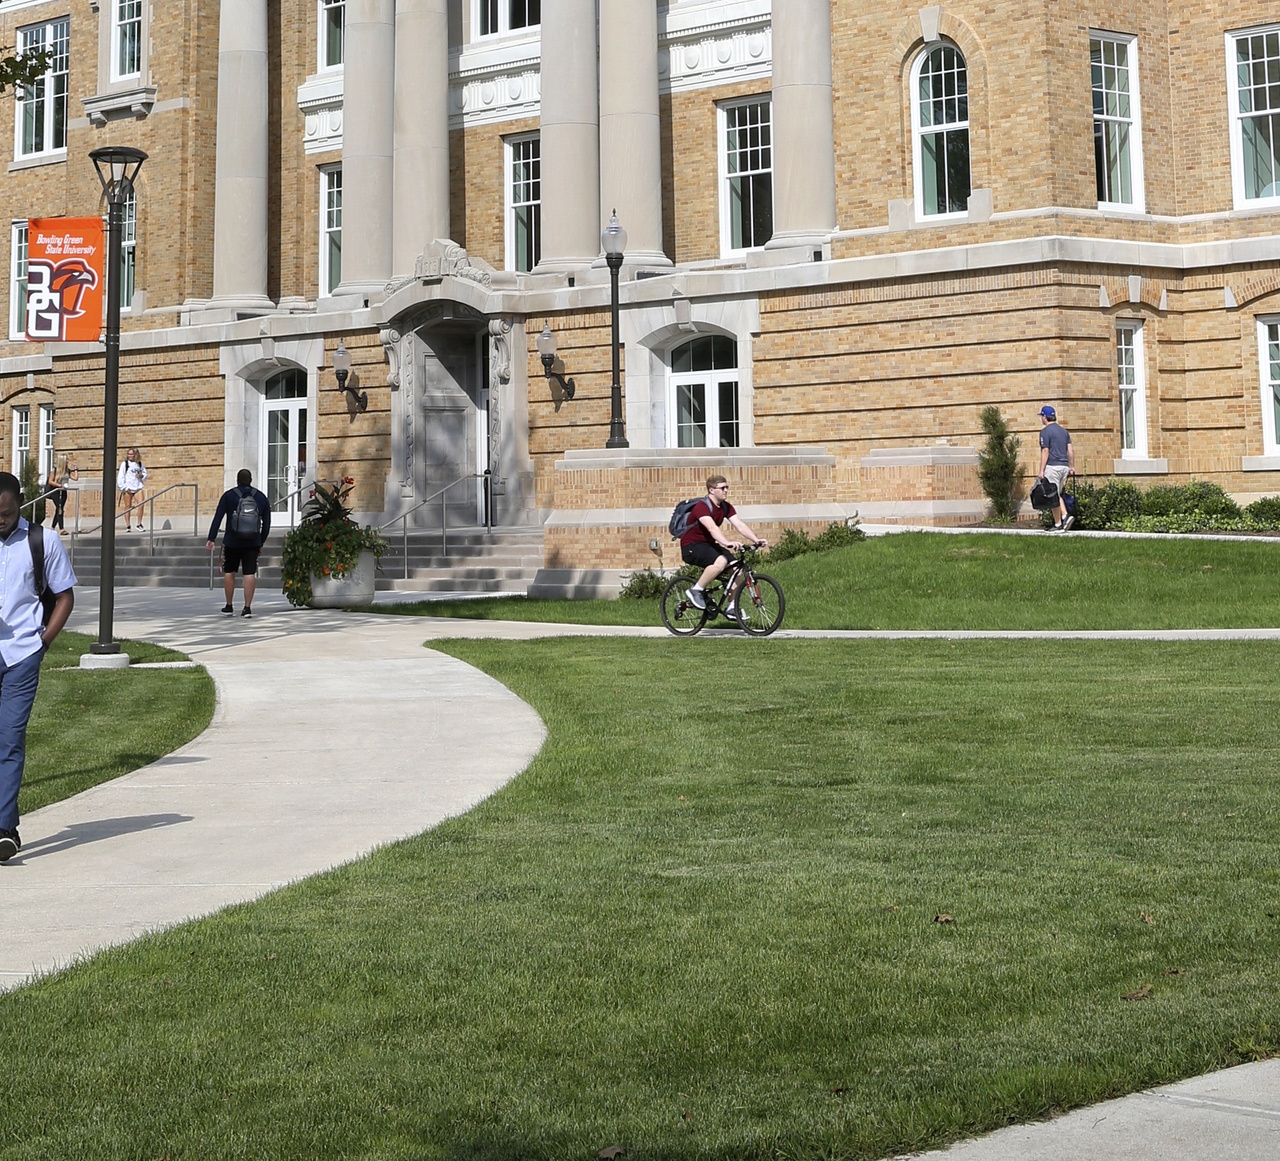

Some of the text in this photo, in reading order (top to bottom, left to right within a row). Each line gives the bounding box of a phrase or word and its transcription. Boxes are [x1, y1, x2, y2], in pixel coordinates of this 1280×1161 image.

[36, 234, 84, 246] Bowling Green
[45, 244, 97, 256] State University
